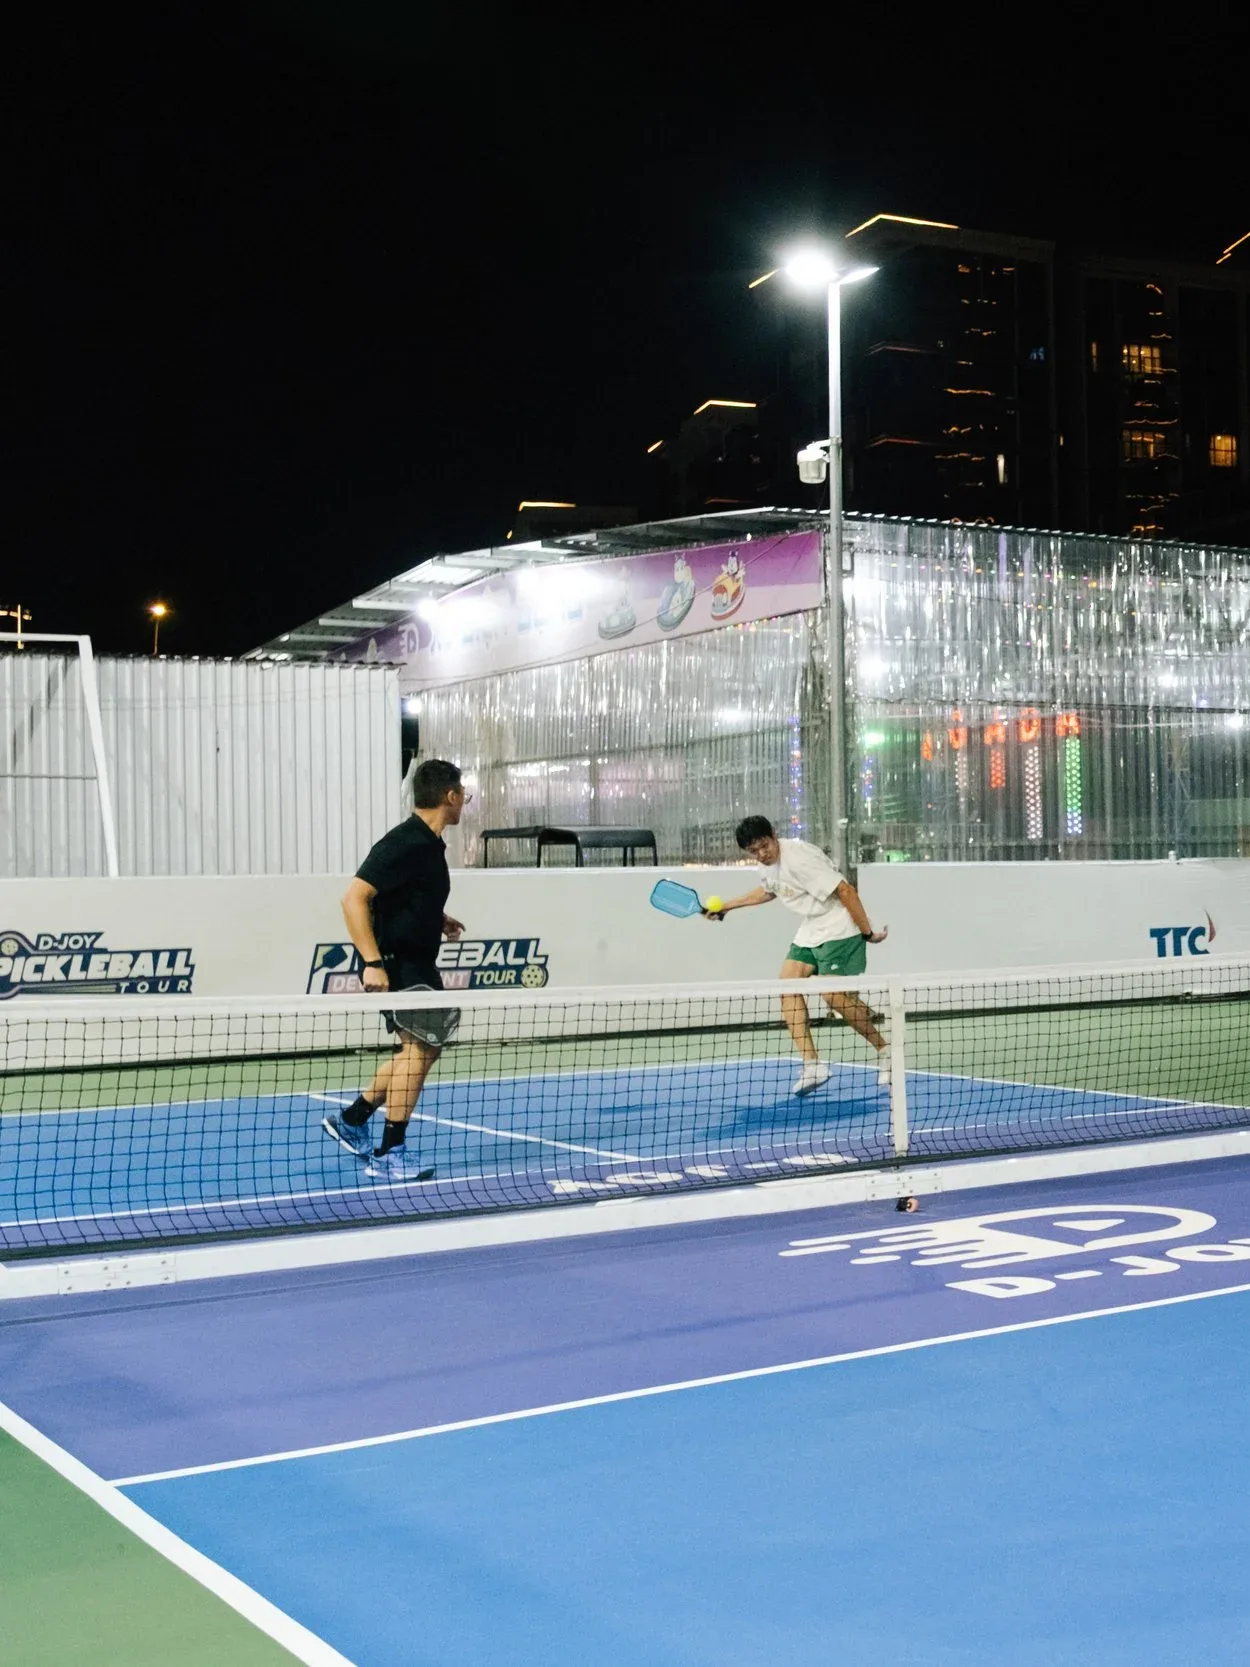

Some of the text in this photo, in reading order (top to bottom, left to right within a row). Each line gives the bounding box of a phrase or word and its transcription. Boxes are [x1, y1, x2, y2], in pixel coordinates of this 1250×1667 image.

[38, 934, 97, 950] D-JOY
[1149, 926, 1210, 957] TTC
[474, 970, 516, 985] TOUR
[118, 979, 190, 993] TOUR
